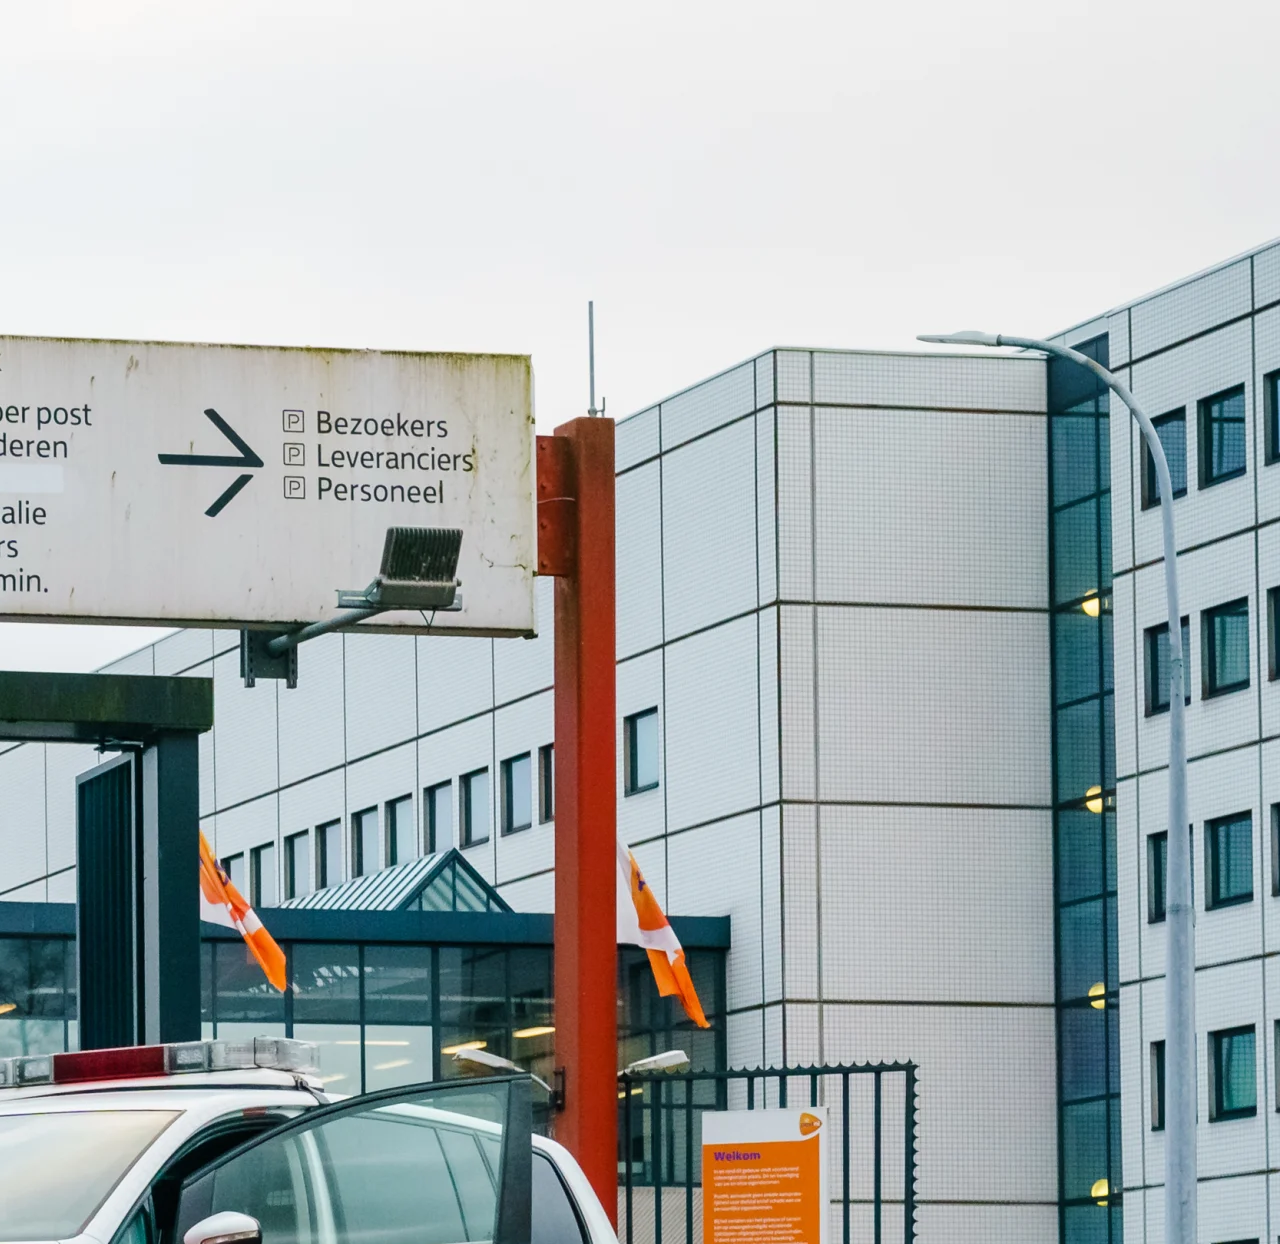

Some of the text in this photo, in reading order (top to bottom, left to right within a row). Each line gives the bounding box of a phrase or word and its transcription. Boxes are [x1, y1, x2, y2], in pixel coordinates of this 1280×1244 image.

[37, 404, 93, 431] post
[316, 410, 449, 438] Bezoekers
[317, 444, 474, 472] Leveranciers
[318, 476, 444, 504] Personeel
[713, 1150, 761, 1162] Welkom
